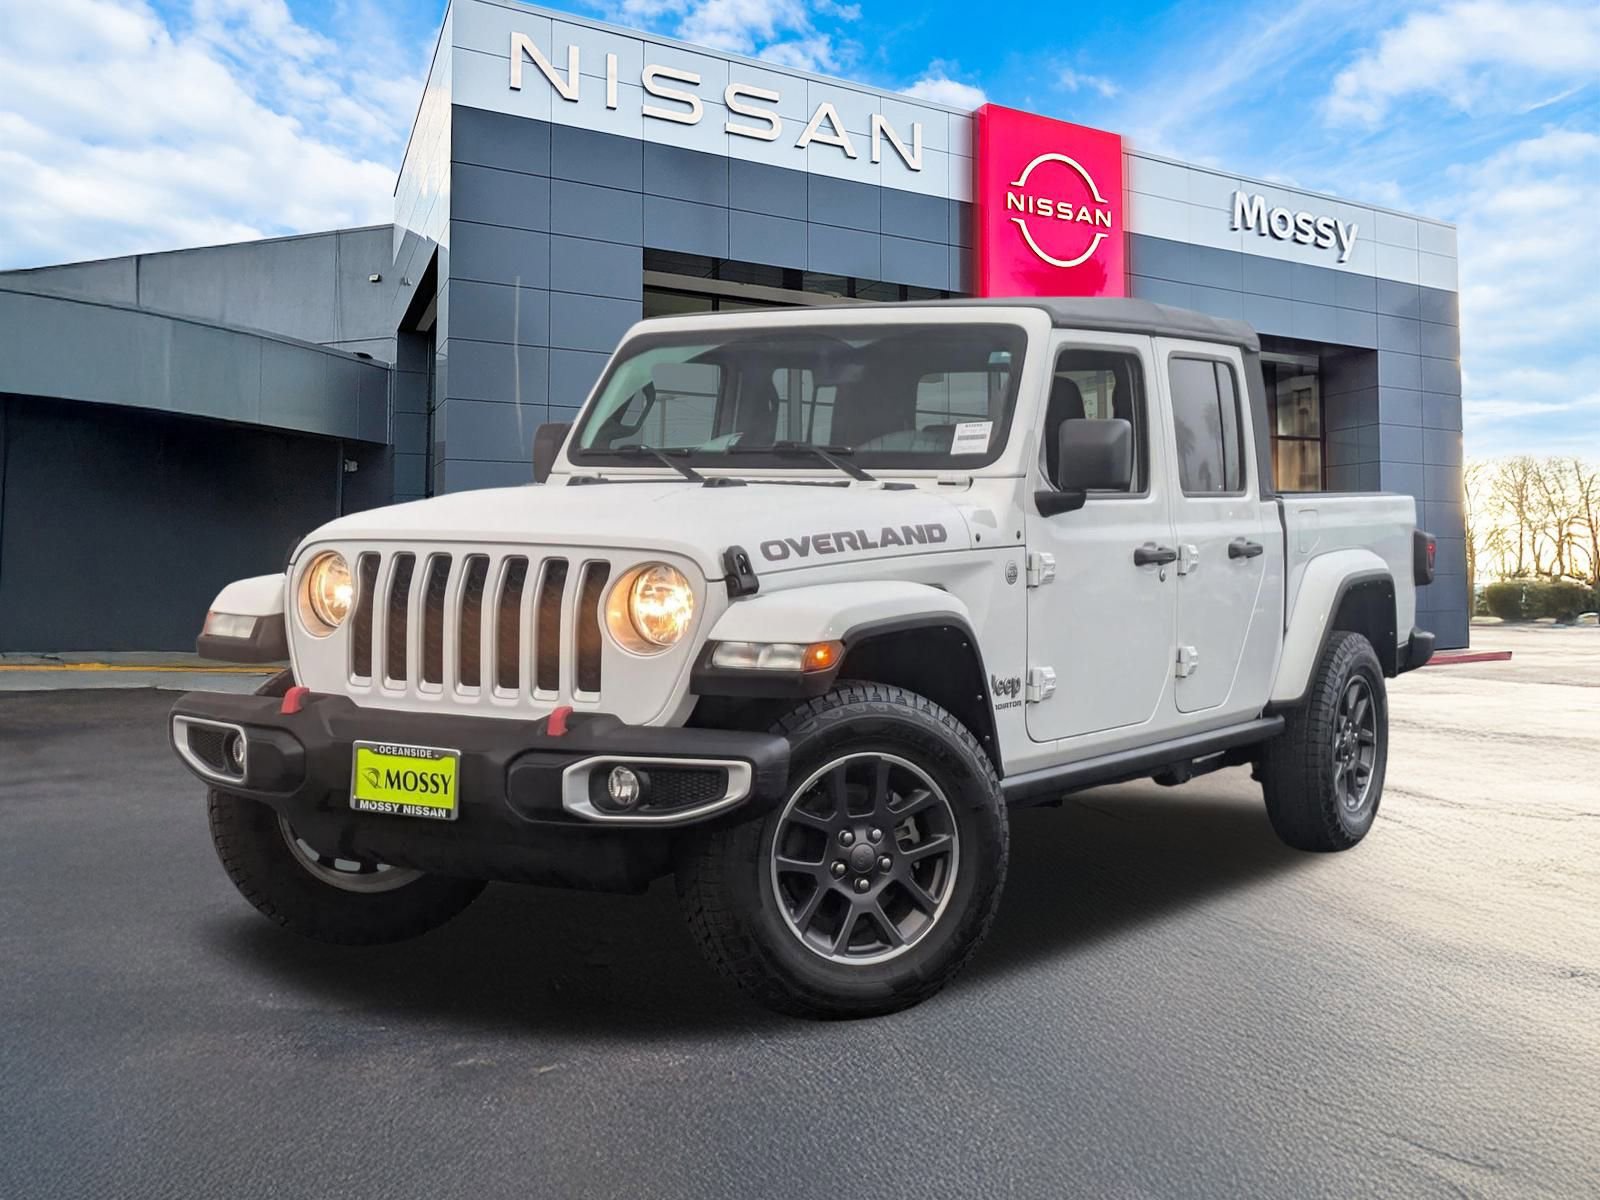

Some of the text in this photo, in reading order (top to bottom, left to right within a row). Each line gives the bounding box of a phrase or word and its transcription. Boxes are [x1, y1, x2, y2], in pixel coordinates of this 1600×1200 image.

[508, 31, 923, 172] NISSAN
[1007, 191, 1112, 228] NISSAN
[1230, 190, 1359, 263] Mossy
[760, 523, 948, 562] OVERLAND
[995, 700, 1021, 711] DIATOR
[379, 745, 433, 759] OCEANSIDE
[384, 768, 452, 795] MOSSY
[359, 799, 446, 818] MOSSY NISSAN
